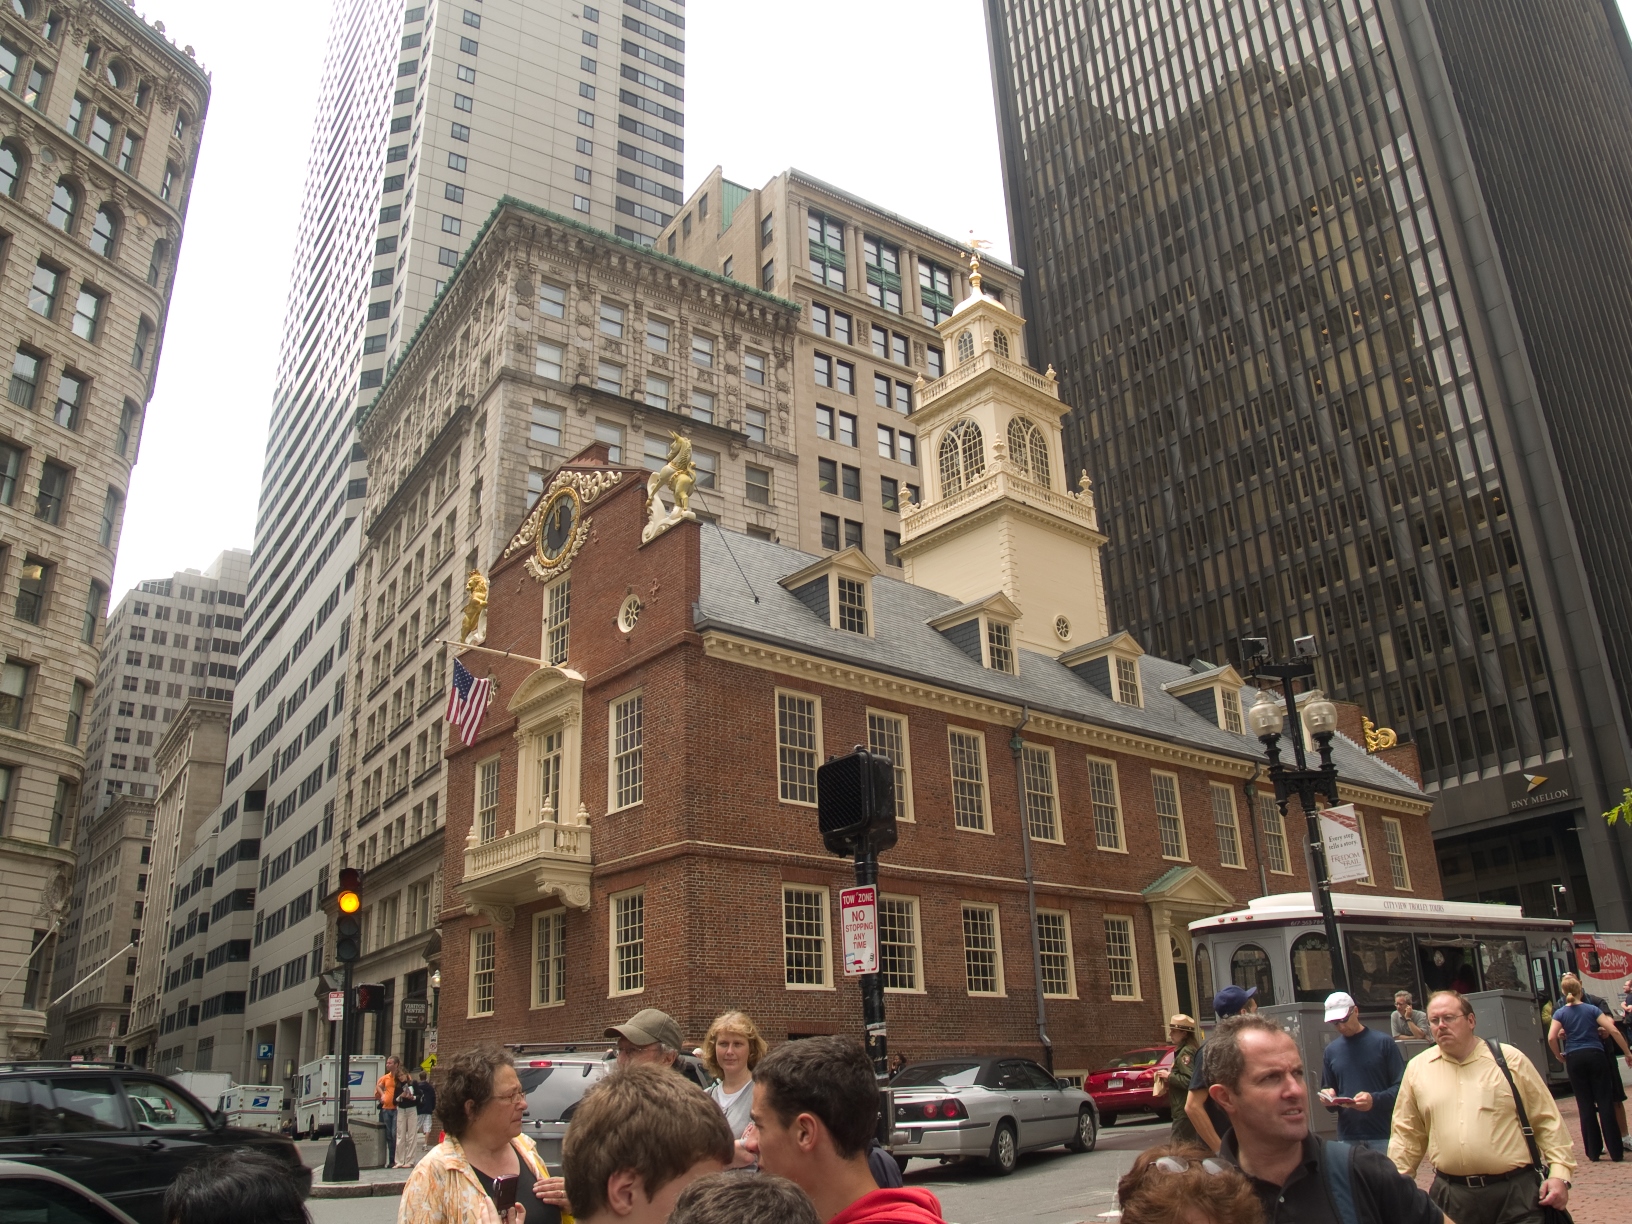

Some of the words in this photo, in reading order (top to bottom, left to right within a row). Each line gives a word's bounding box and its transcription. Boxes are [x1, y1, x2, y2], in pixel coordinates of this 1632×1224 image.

[1511, 798, 1529, 809] BNY
[1531, 788, 1569, 804] MELLON
[1328, 842, 1339, 850] tells
[1330, 852, 1360, 863] FREEDOM
[1343, 858, 1361, 867] TRAIL
[843, 893, 855, 905] TOW
[857, 892, 874, 903] ZONE
[1408, 902, 1428, 911] TROLLEY
[1429, 904, 1445, 912] TOURS
[851, 909, 865, 922] NO
[845, 922, 874, 933] STOPPING
[853, 932, 866, 941] ANY
[852, 940, 867, 950] TIME
[259, 1045, 269, 1057] P
